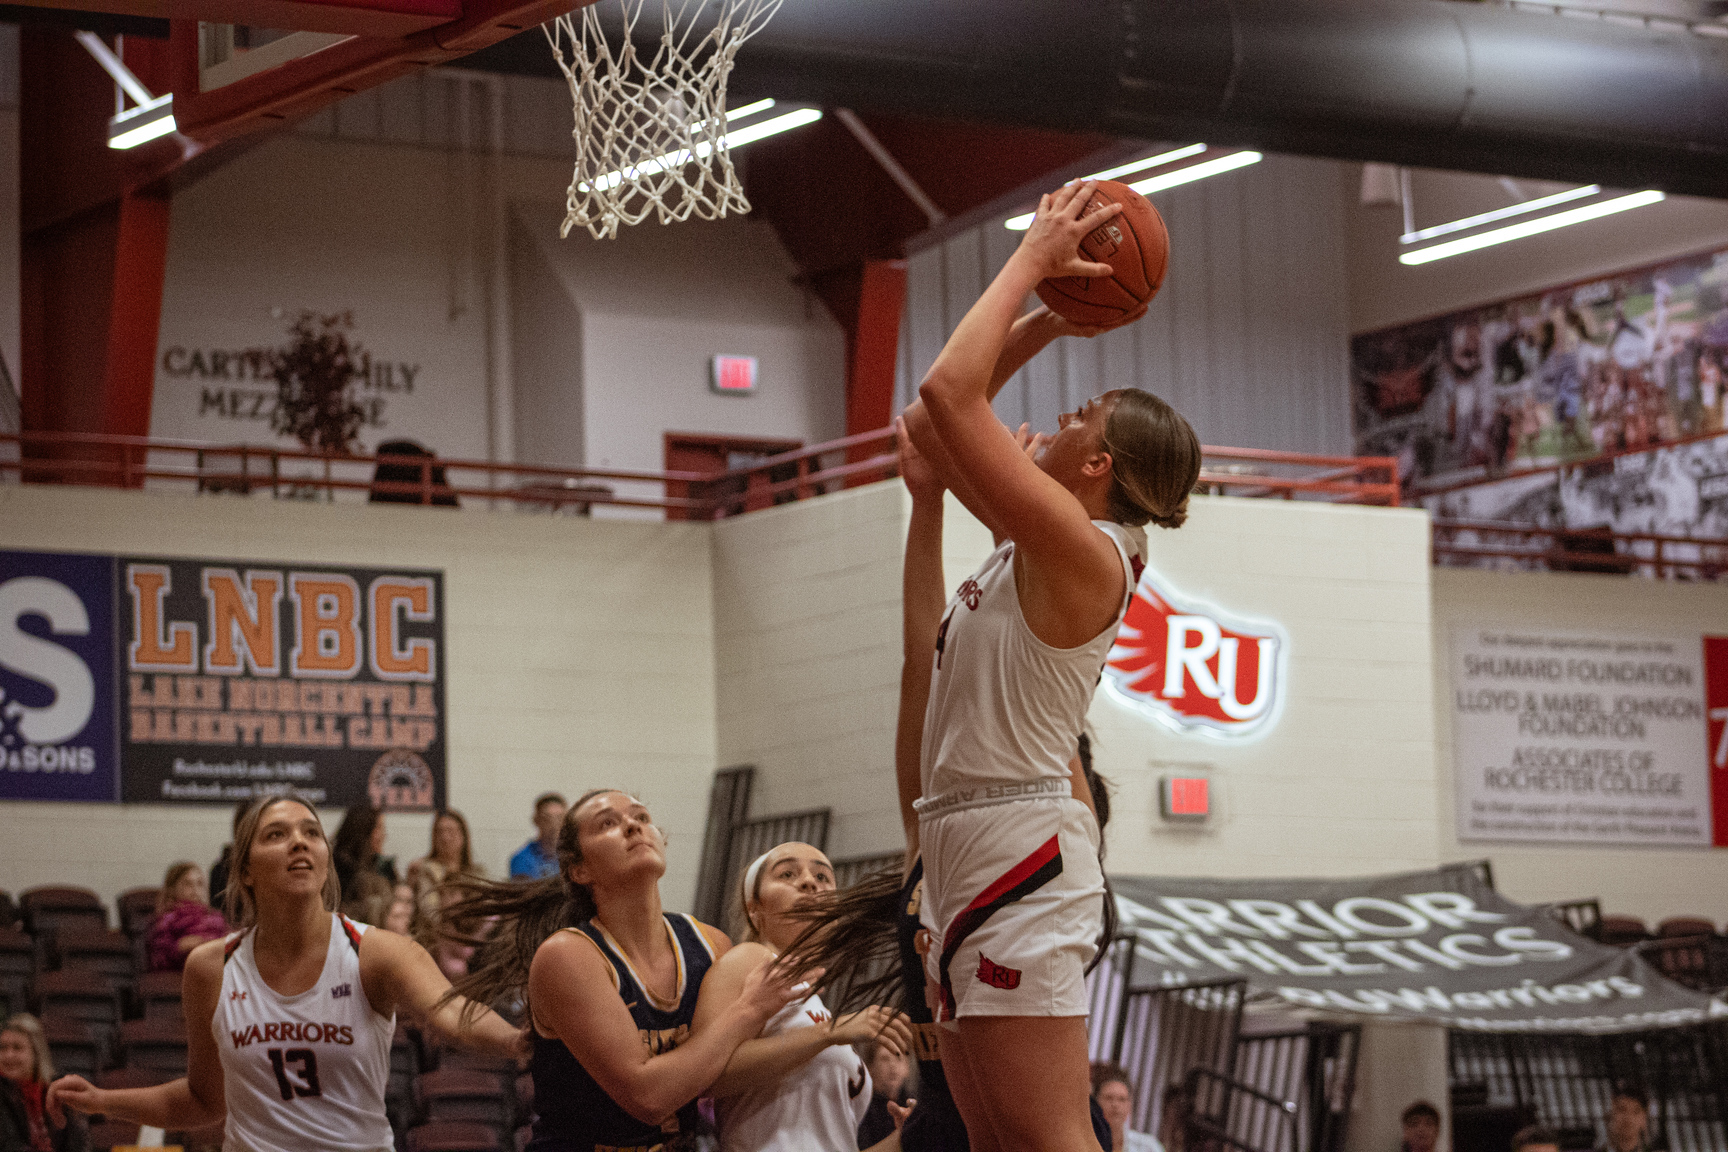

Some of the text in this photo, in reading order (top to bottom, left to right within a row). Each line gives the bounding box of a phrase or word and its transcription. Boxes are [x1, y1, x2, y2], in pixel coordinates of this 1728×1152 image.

[163, 346, 278, 382] CARTE
[126, 564, 436, 682] LNBC
[1163, 615, 1276, 721] RU
[1566, 657, 1692, 686] FOUNDATION
[1518, 712, 1647, 739] FOUNDATION
[1112, 892, 1506, 939] ARRIOR
[230, 1021, 354, 1050] WARRIORS
[267, 1048, 322, 1101] 13
